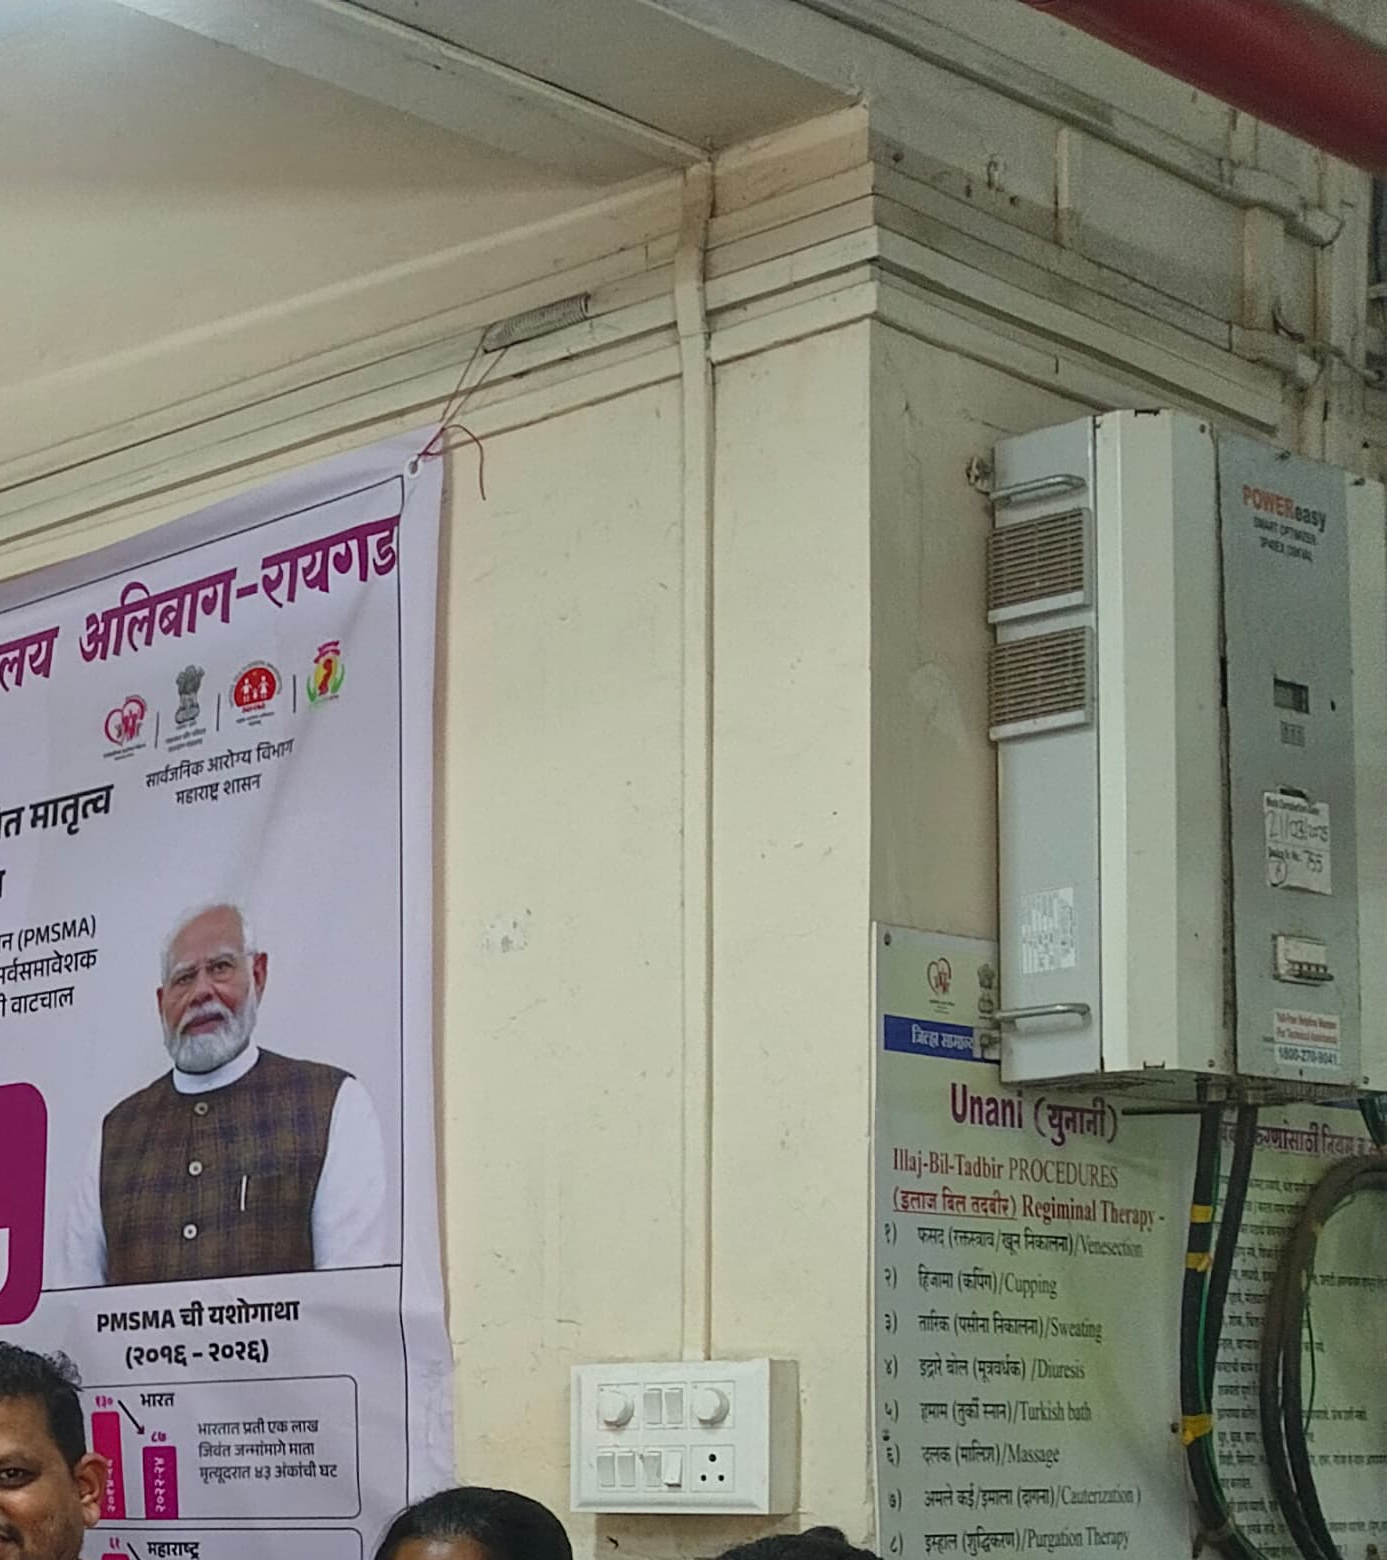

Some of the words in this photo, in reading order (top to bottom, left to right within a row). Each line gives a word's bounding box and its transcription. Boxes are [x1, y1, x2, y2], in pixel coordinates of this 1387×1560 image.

[207, 748, 252, 773] आरोग्य
[257, 738, 295, 762] विभाग
[223, 774, 262, 795] शासन
[30, 782, 116, 840] मातृत्व
[17, 914, 97, 951] (PMSMA)
[11, 985, 75, 1016] वाटचाल
[951, 1082, 1023, 1129] Unani
[1034, 1096, 1117, 1146] (युनानी)
[893, 1147, 1004, 1180] Illaj-Bil-Tadbir
[1009, 1156, 1118, 1188] PROCEDURES
[1102, 1200, 1154, 1232] Therapy
[97, 1309, 176, 1332] PMSMA
[180, 1300, 203, 1328] ची
[208, 1297, 300, 1324] यशोगाथा
[139, 1392, 175, 1408] भारत
[1068, 1400, 1092, 1420] bath
[268, 1421, 288, 1434] एक
[289, 1442, 315, 1456] माता
[147, 1541, 200, 1559] महाराष्ट्र
[1085, 1525, 1128, 1549] Therapy
